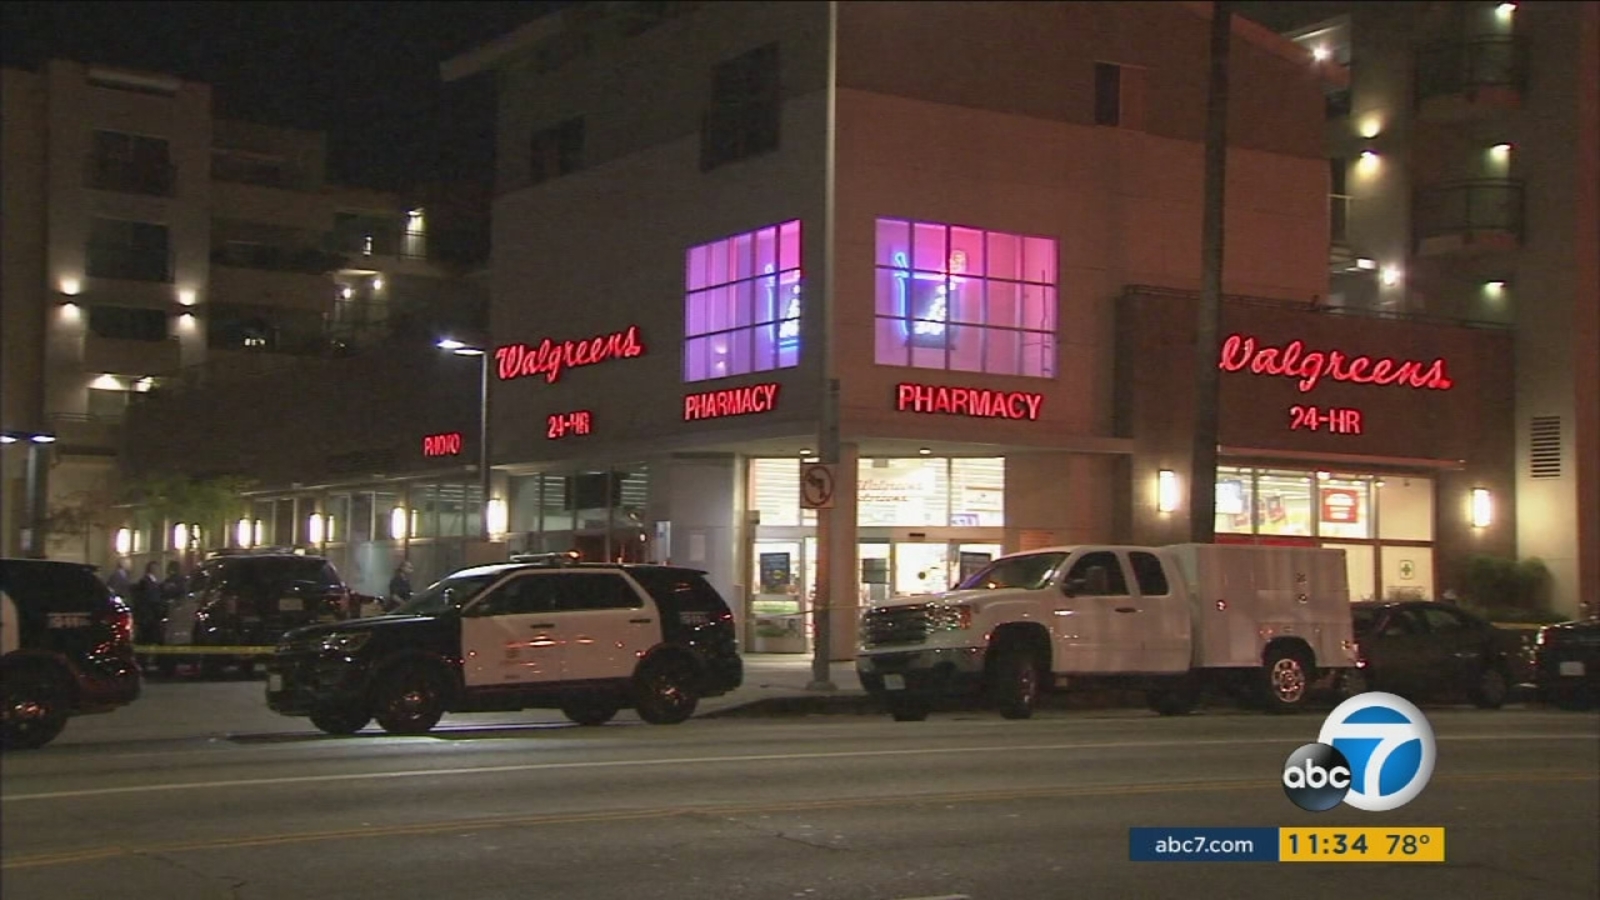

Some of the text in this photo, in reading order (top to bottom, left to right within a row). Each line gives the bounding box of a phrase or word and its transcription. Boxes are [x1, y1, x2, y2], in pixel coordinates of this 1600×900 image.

[495, 326, 641, 382] Walgreens
[685, 384, 777, 420] PHARMACY
[897, 383, 1043, 420] PHARMACY
[1290, 406, 1361, 433] 24-HR
[548, 411, 590, 438] 24-HR
